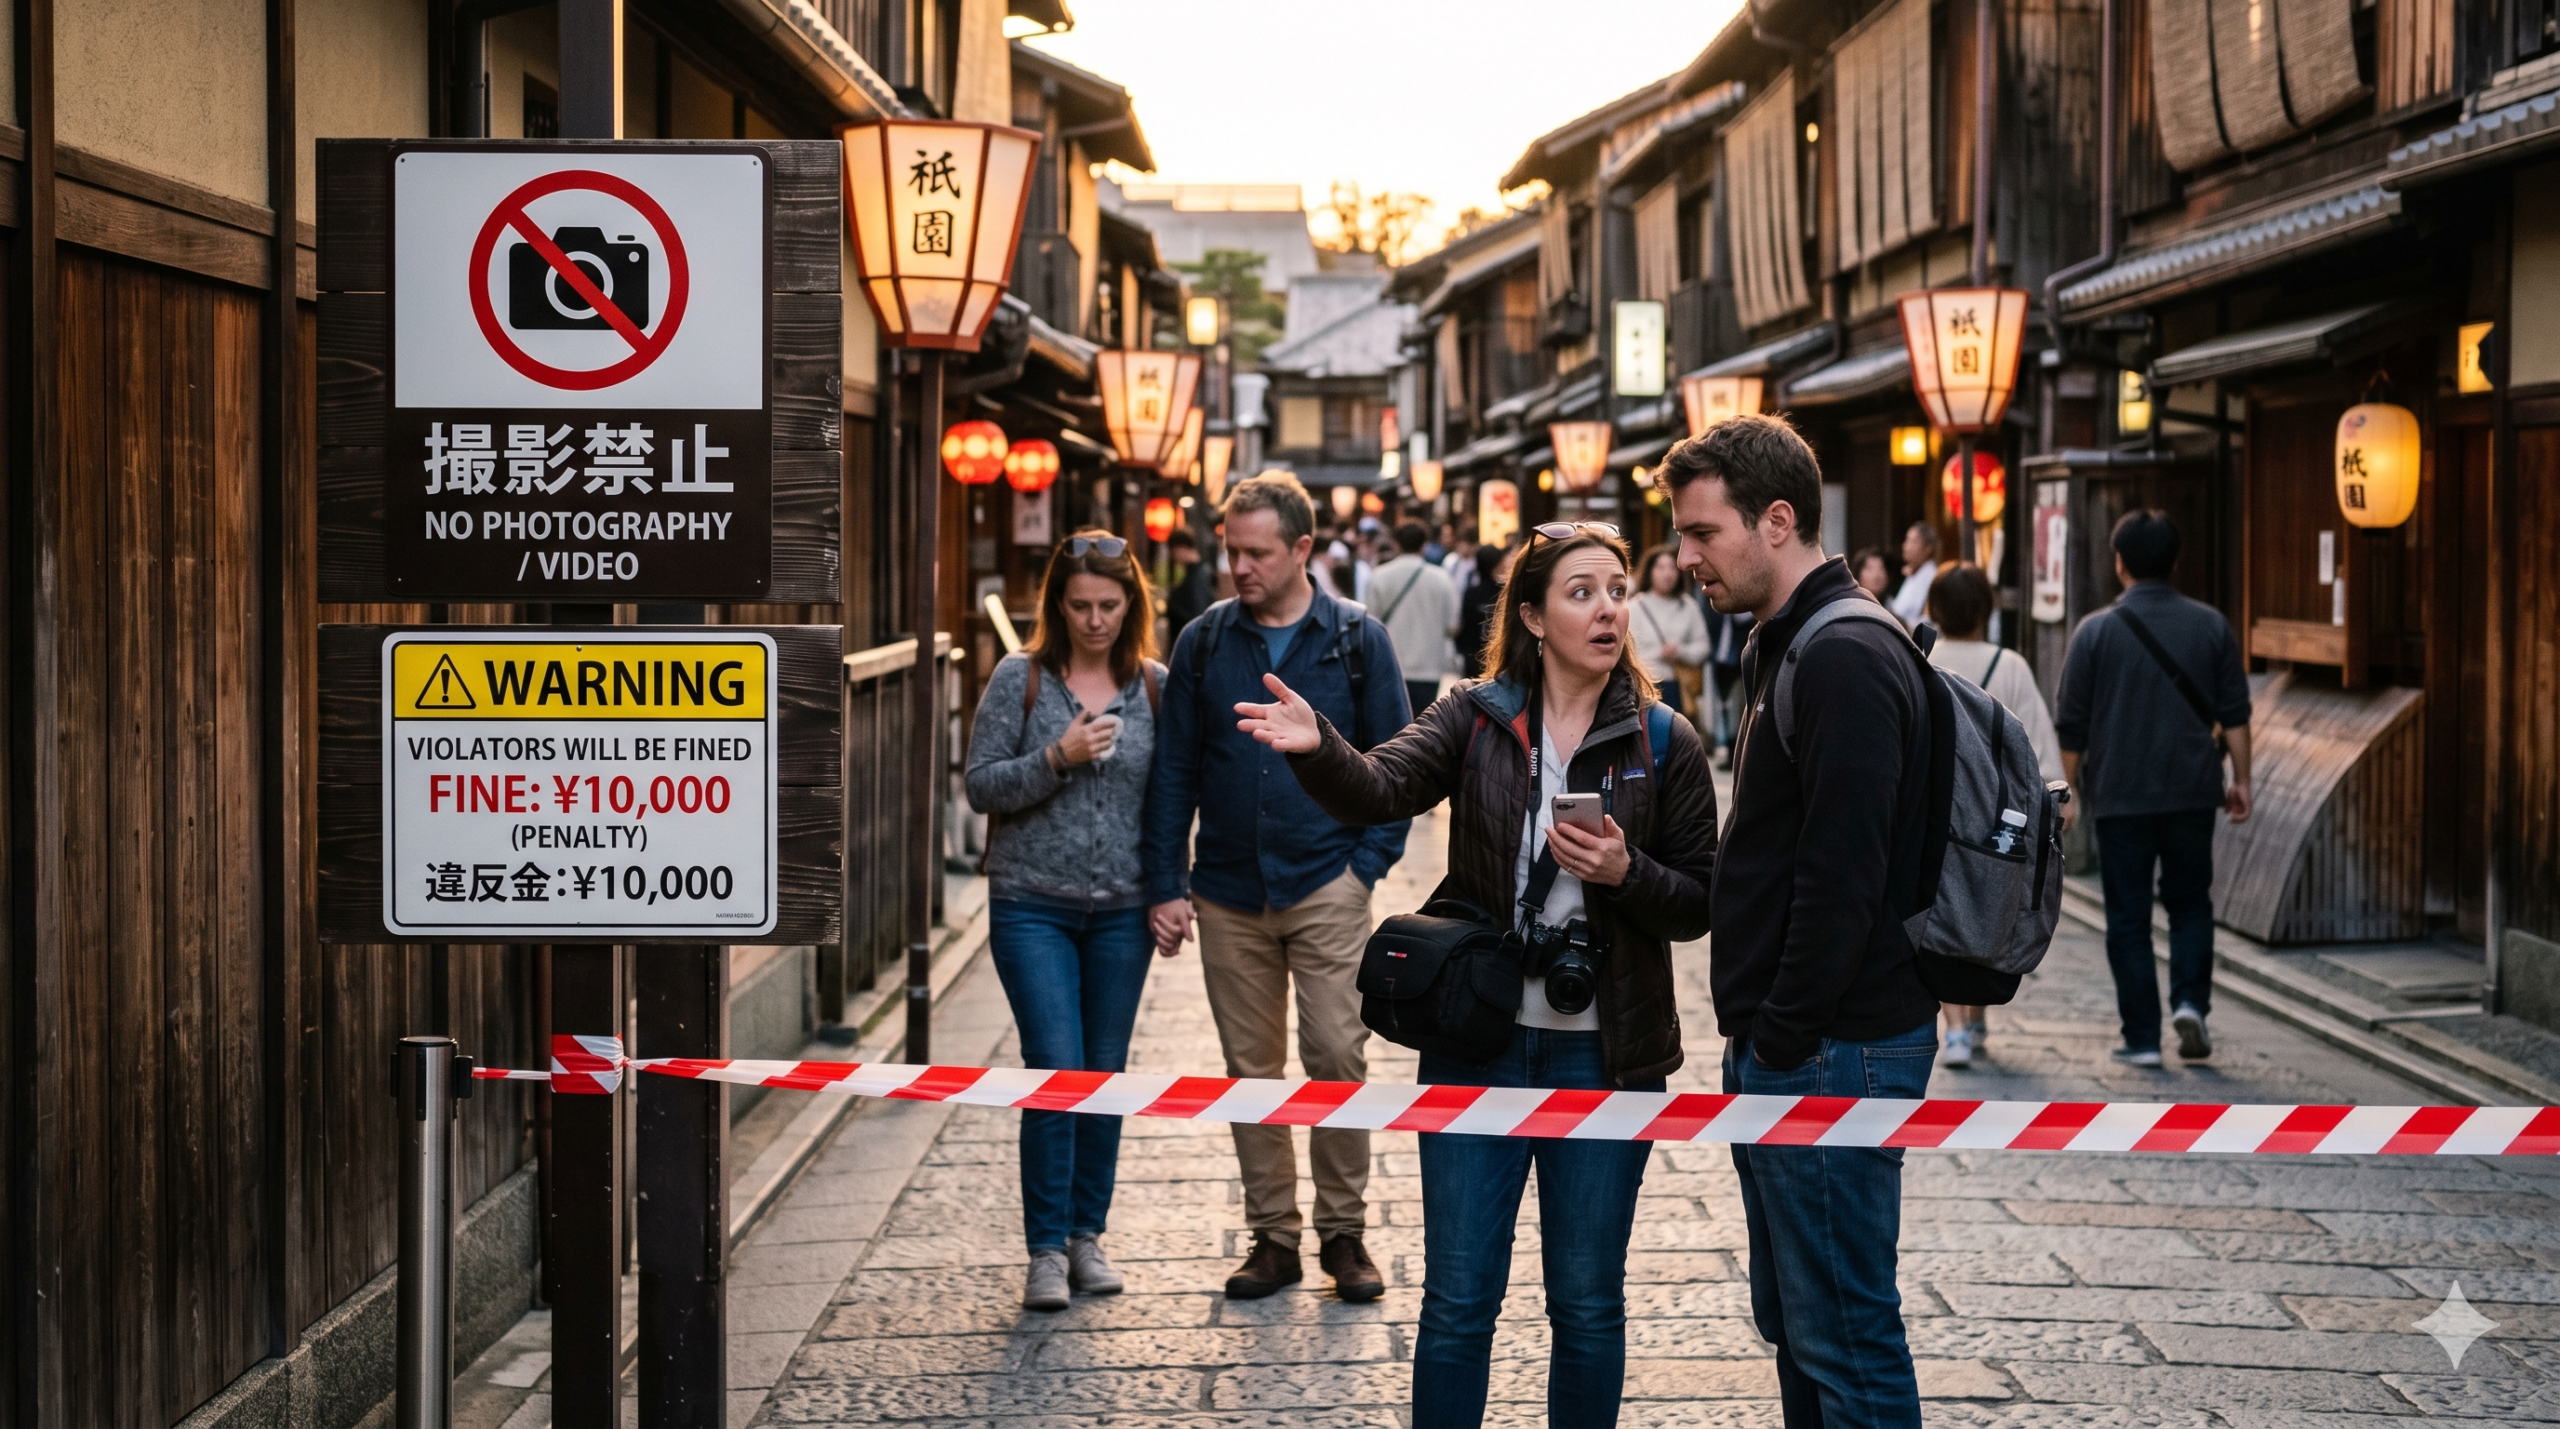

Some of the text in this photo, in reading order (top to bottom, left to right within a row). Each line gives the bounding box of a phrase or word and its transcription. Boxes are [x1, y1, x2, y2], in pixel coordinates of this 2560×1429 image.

[908, 149, 961, 258] 祇園
[423, 421, 734, 496] 撮影禁止
[425, 510, 733, 541] NO PHOTOGRAPHY
[537, 551, 639, 581] VIDEO
[483, 660, 745, 707] WARNING
[407, 737, 752, 761] VIOLATORS WILL BE FINED
[430, 774, 731, 820] FINE: ¥10,000
[511, 823, 648, 853] (PENALTY)
